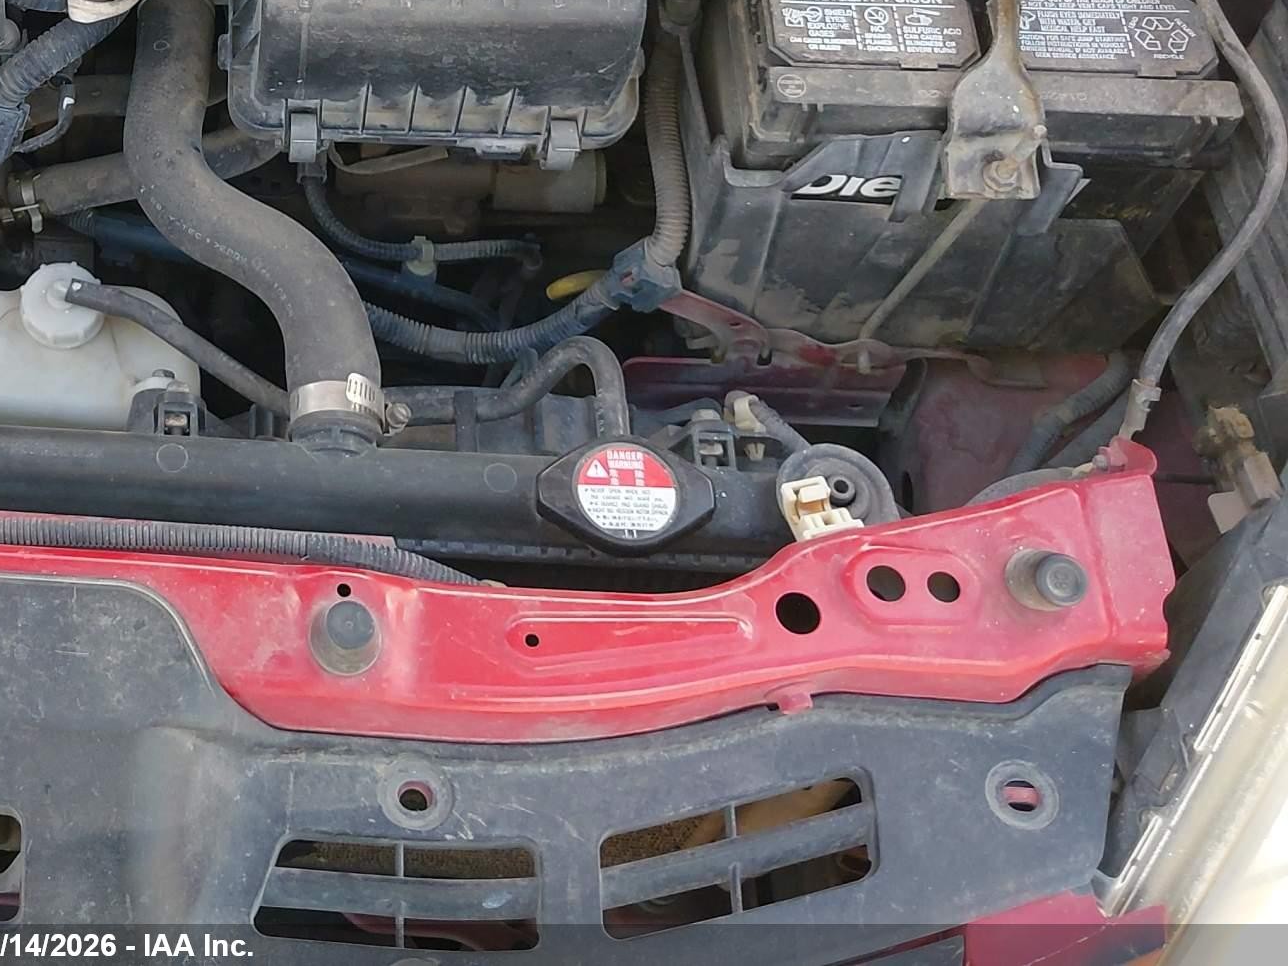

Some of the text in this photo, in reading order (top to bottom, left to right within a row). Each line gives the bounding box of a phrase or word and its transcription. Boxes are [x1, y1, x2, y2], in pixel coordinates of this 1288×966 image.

[824, 8, 852, 16] SHIELD
[807, 22, 852, 30] EXPLOSIVE
[607, 449, 645, 460] DANGER
[607, 460, 645, 469] WARNING
